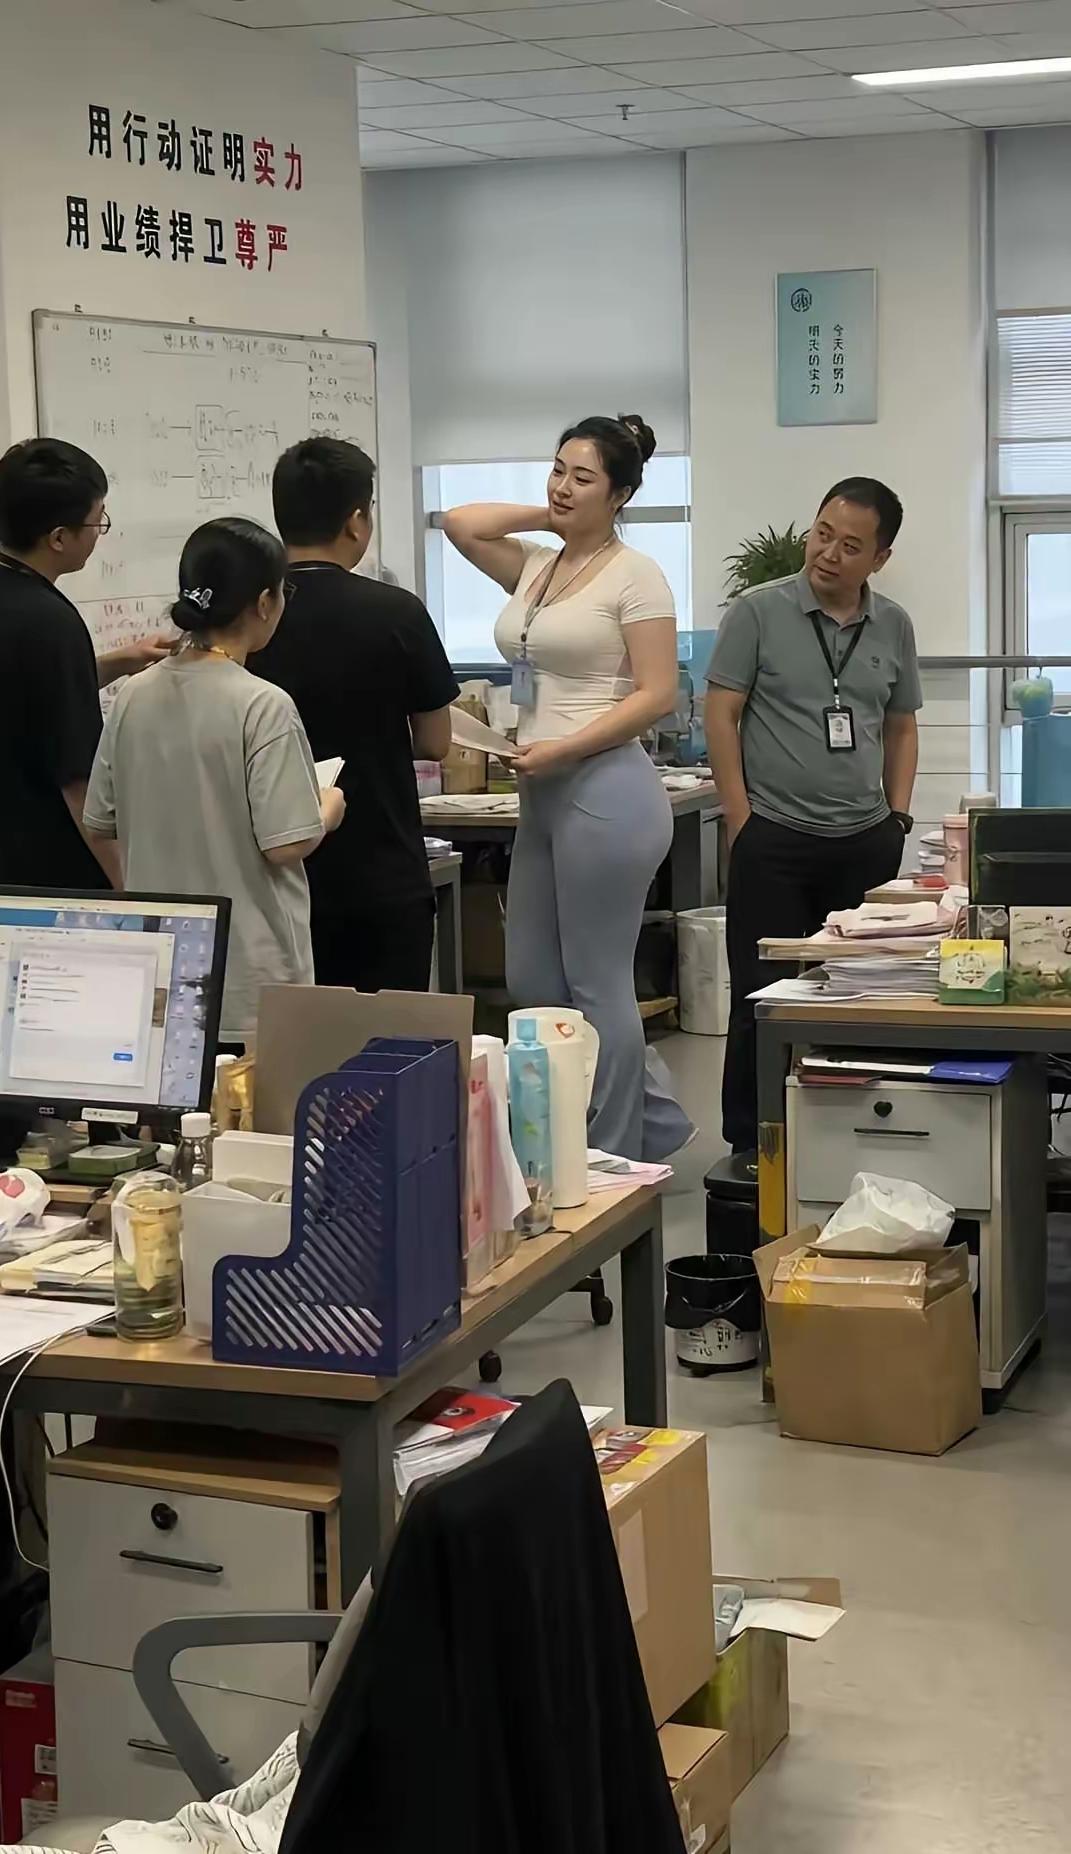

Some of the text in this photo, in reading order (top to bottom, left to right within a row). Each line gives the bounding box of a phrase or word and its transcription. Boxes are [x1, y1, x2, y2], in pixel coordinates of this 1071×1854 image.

[88, 103, 303, 191] 用行动证明实力
[66, 195, 288, 272] 用业绩捍卫尊严
